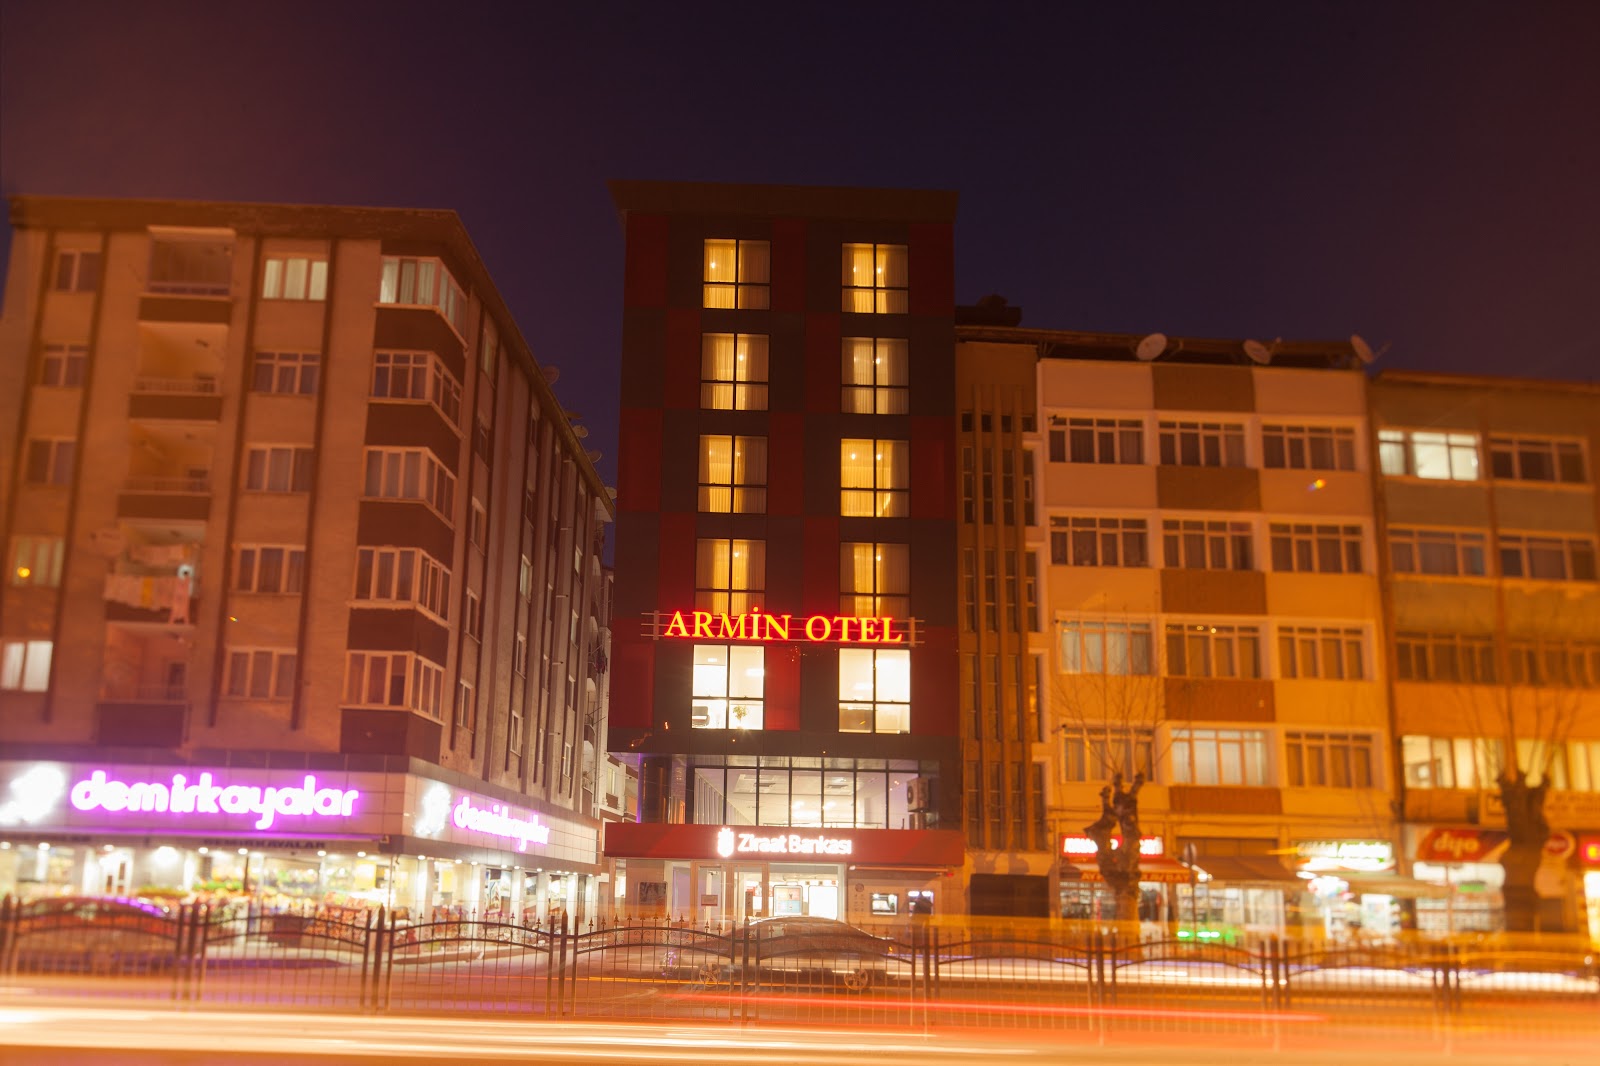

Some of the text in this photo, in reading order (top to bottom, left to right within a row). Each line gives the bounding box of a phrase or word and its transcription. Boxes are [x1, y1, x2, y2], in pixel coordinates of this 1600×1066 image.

[664, 606, 902, 643] ARMİN OTEL
[71, 770, 359, 830] demirkayalar
[453, 796, 550, 851] demirkayalar
[737, 833, 853, 855] Ziraat Bankası
